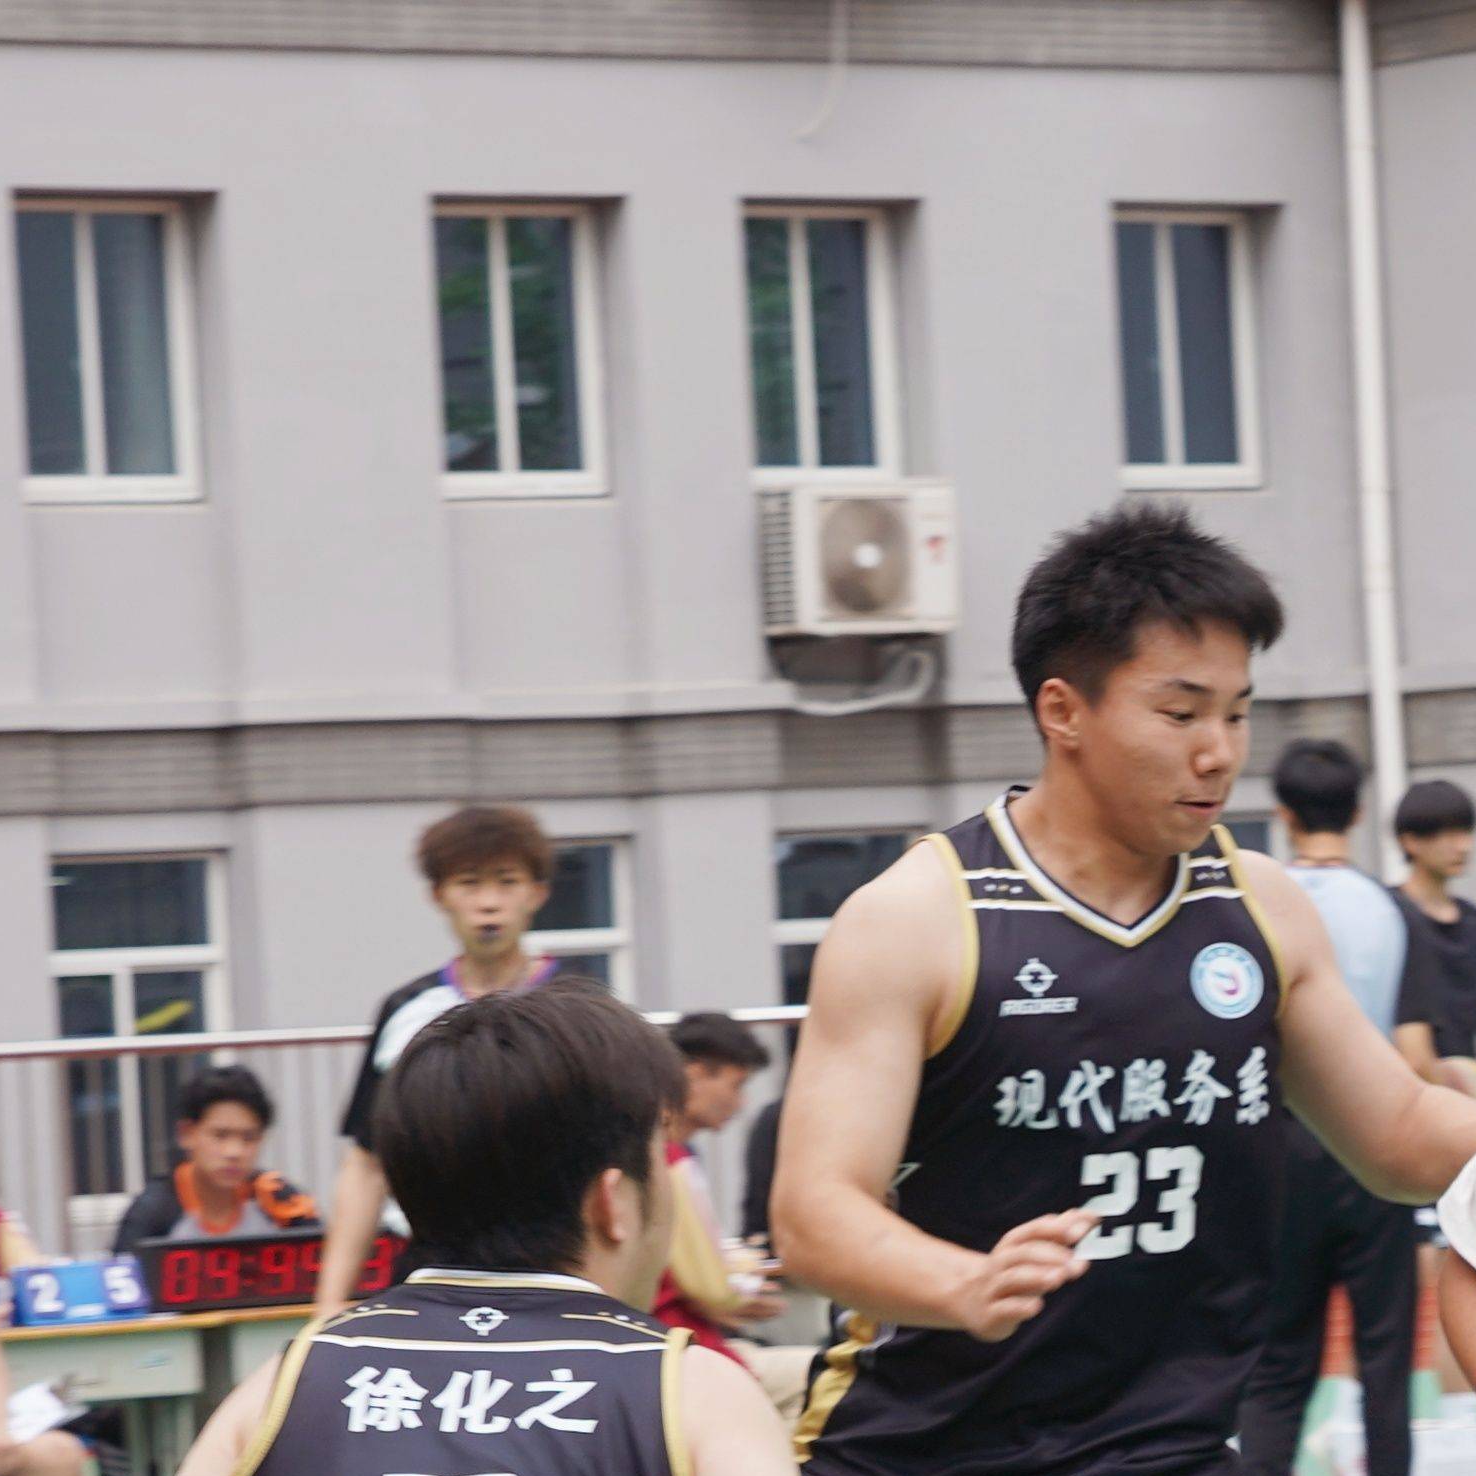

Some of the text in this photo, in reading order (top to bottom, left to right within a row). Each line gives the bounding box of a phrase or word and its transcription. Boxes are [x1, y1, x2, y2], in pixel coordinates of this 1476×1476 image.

[1073, 1145, 1205, 1261] 23
[26, 1272, 65, 1313] 2
[340, 1365, 600, 1434] 徐化之
